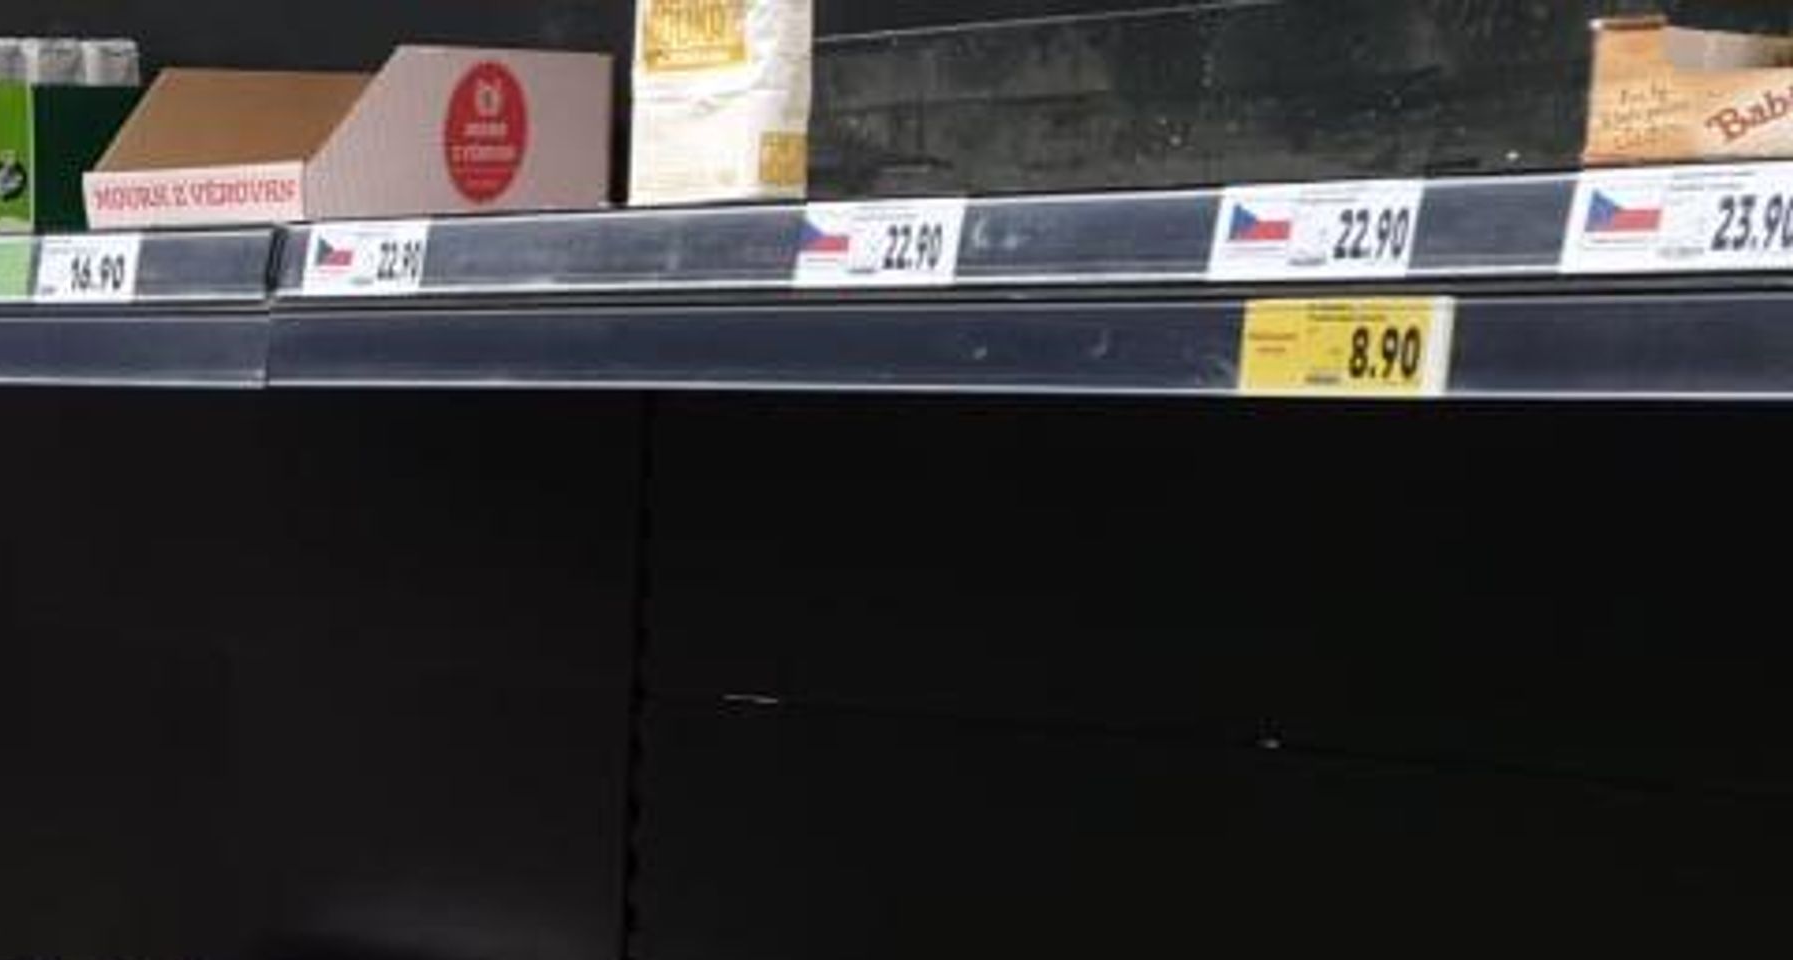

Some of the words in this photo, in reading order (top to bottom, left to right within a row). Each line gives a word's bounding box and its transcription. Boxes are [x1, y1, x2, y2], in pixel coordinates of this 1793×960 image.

[882, 222, 943, 270] 22.90
[1332, 208, 1410, 259] 22.90
[71, 254, 125, 292] 16.90
[1348, 325, 1421, 379] 8.90
